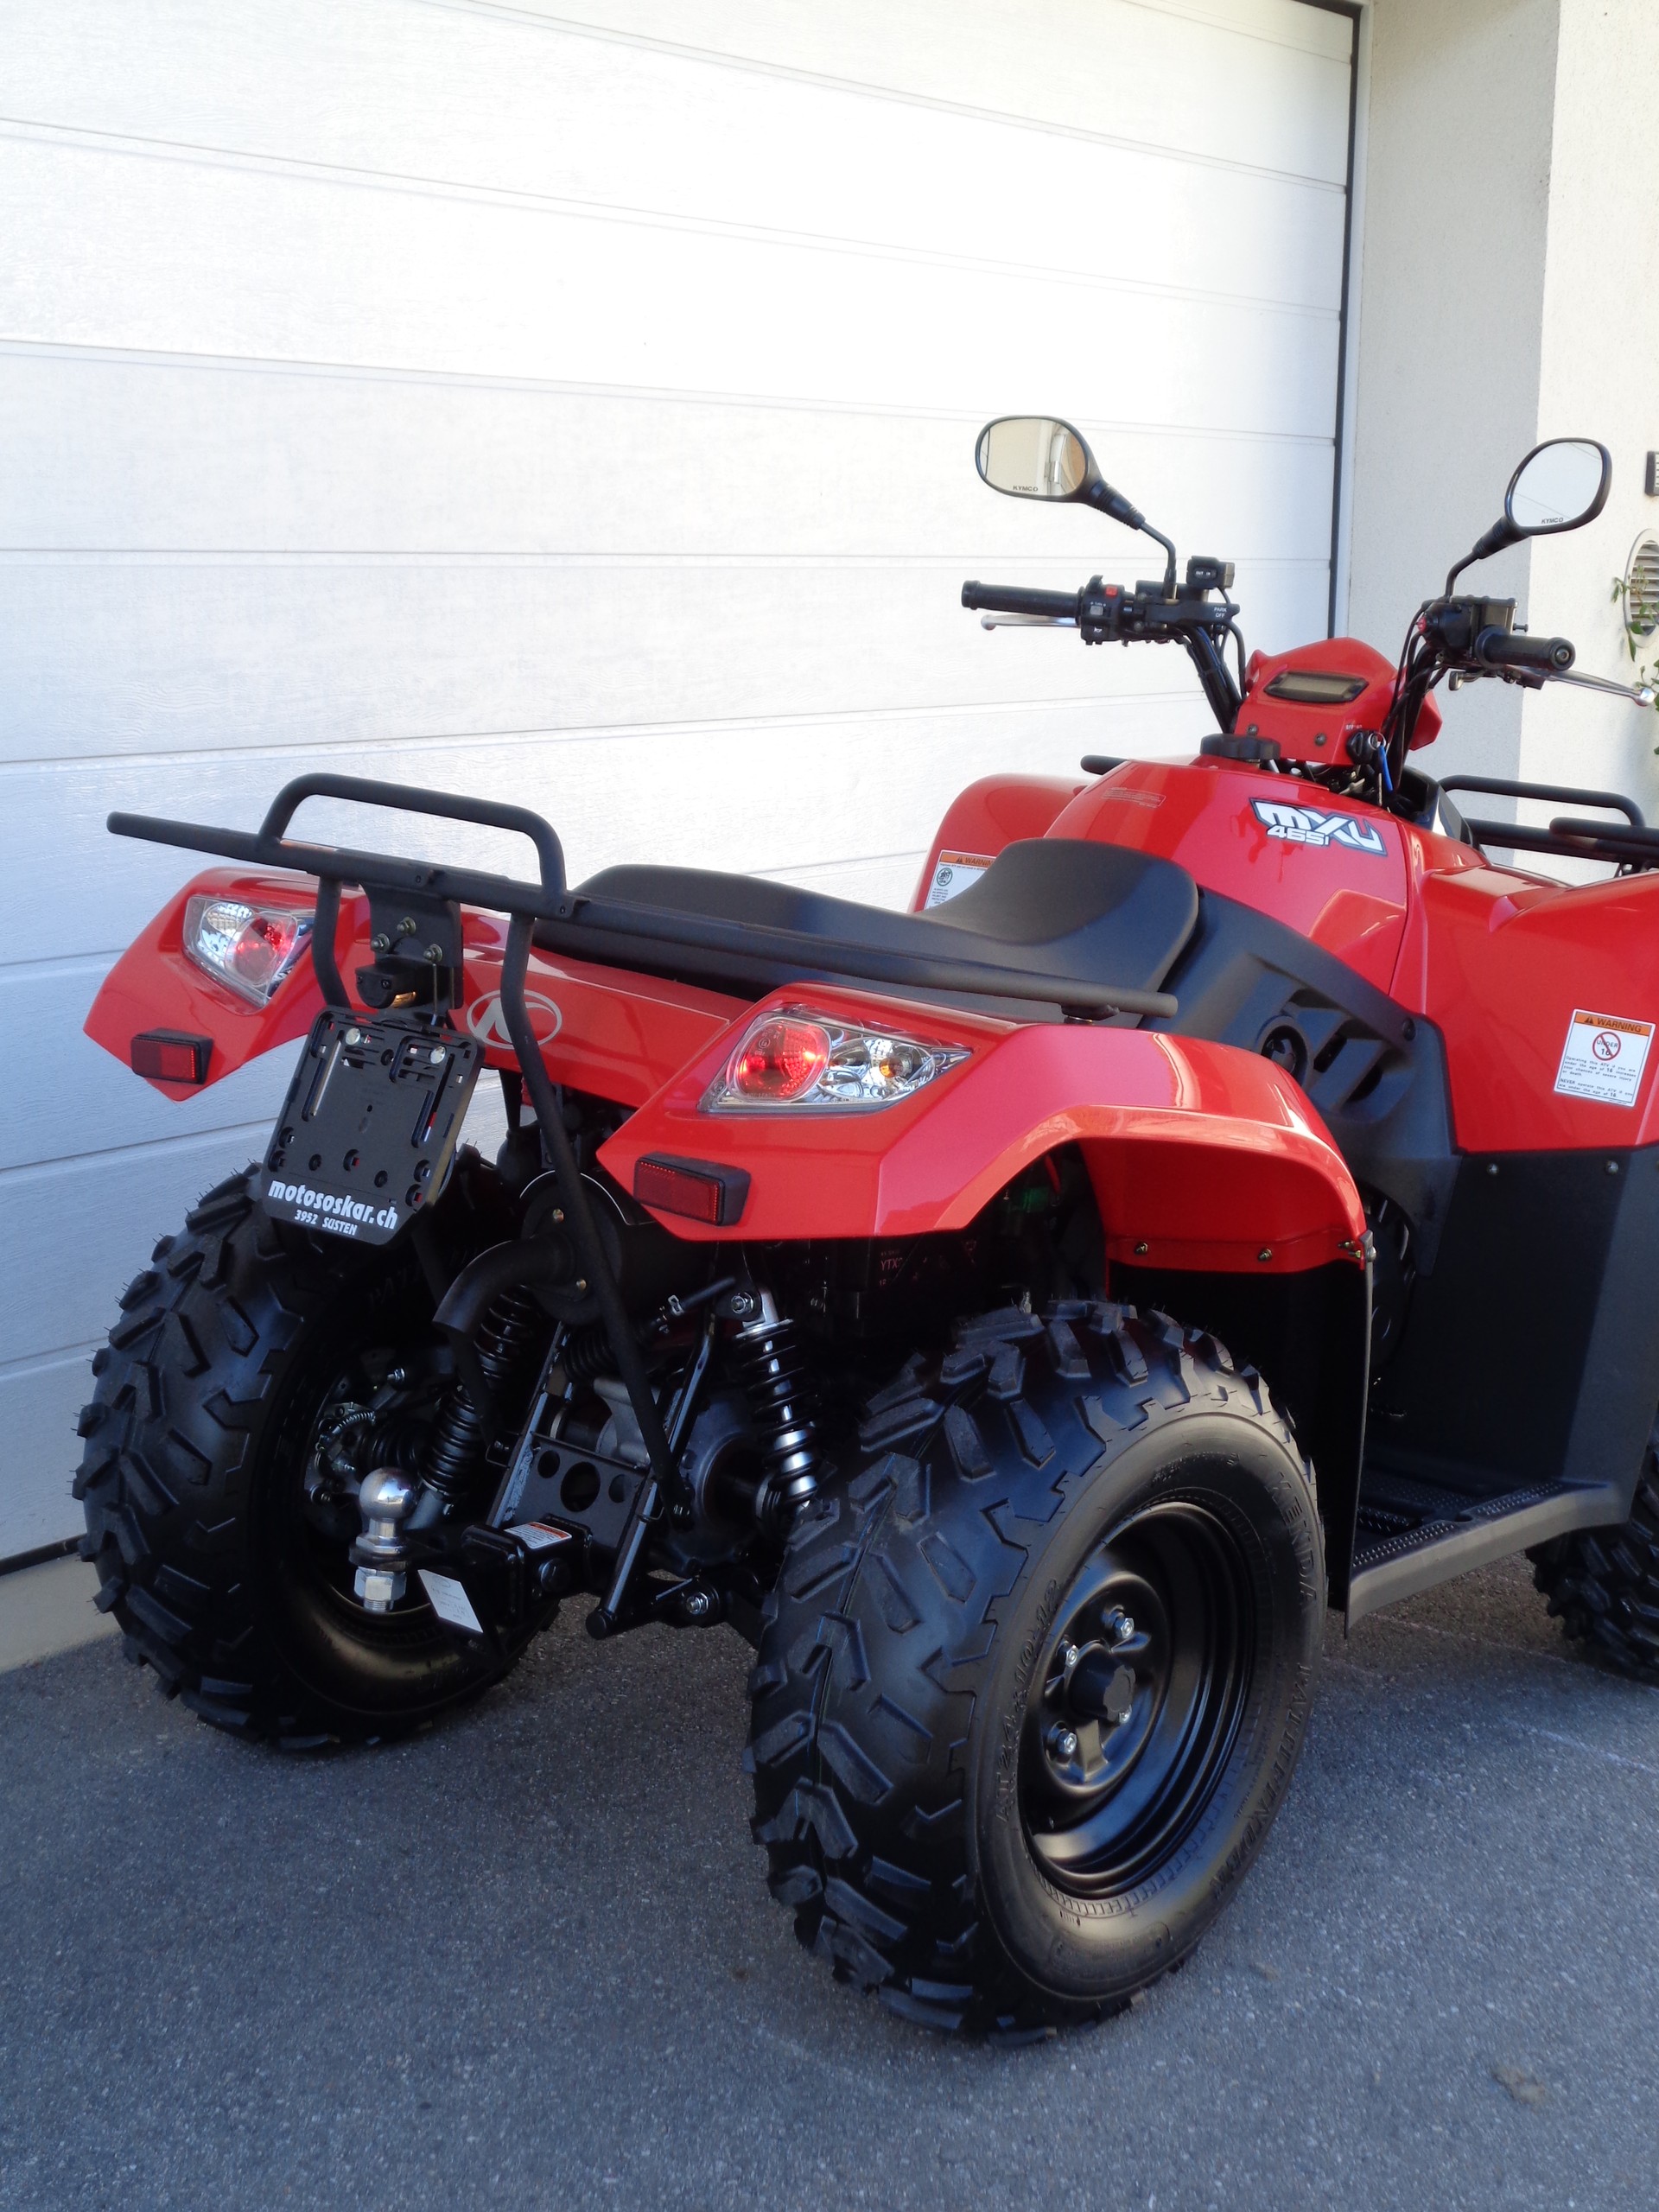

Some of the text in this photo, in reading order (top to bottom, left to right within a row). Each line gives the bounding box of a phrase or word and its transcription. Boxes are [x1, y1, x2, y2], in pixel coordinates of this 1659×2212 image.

[965, 857, 992, 866] WARNIN
[1597, 1018, 1642, 1033] WARNING
[268, 1179, 398, 1230] motososkar.ch
[294, 1209, 319, 1225] 3952
[1265, 1471, 1318, 1608] KENDA
